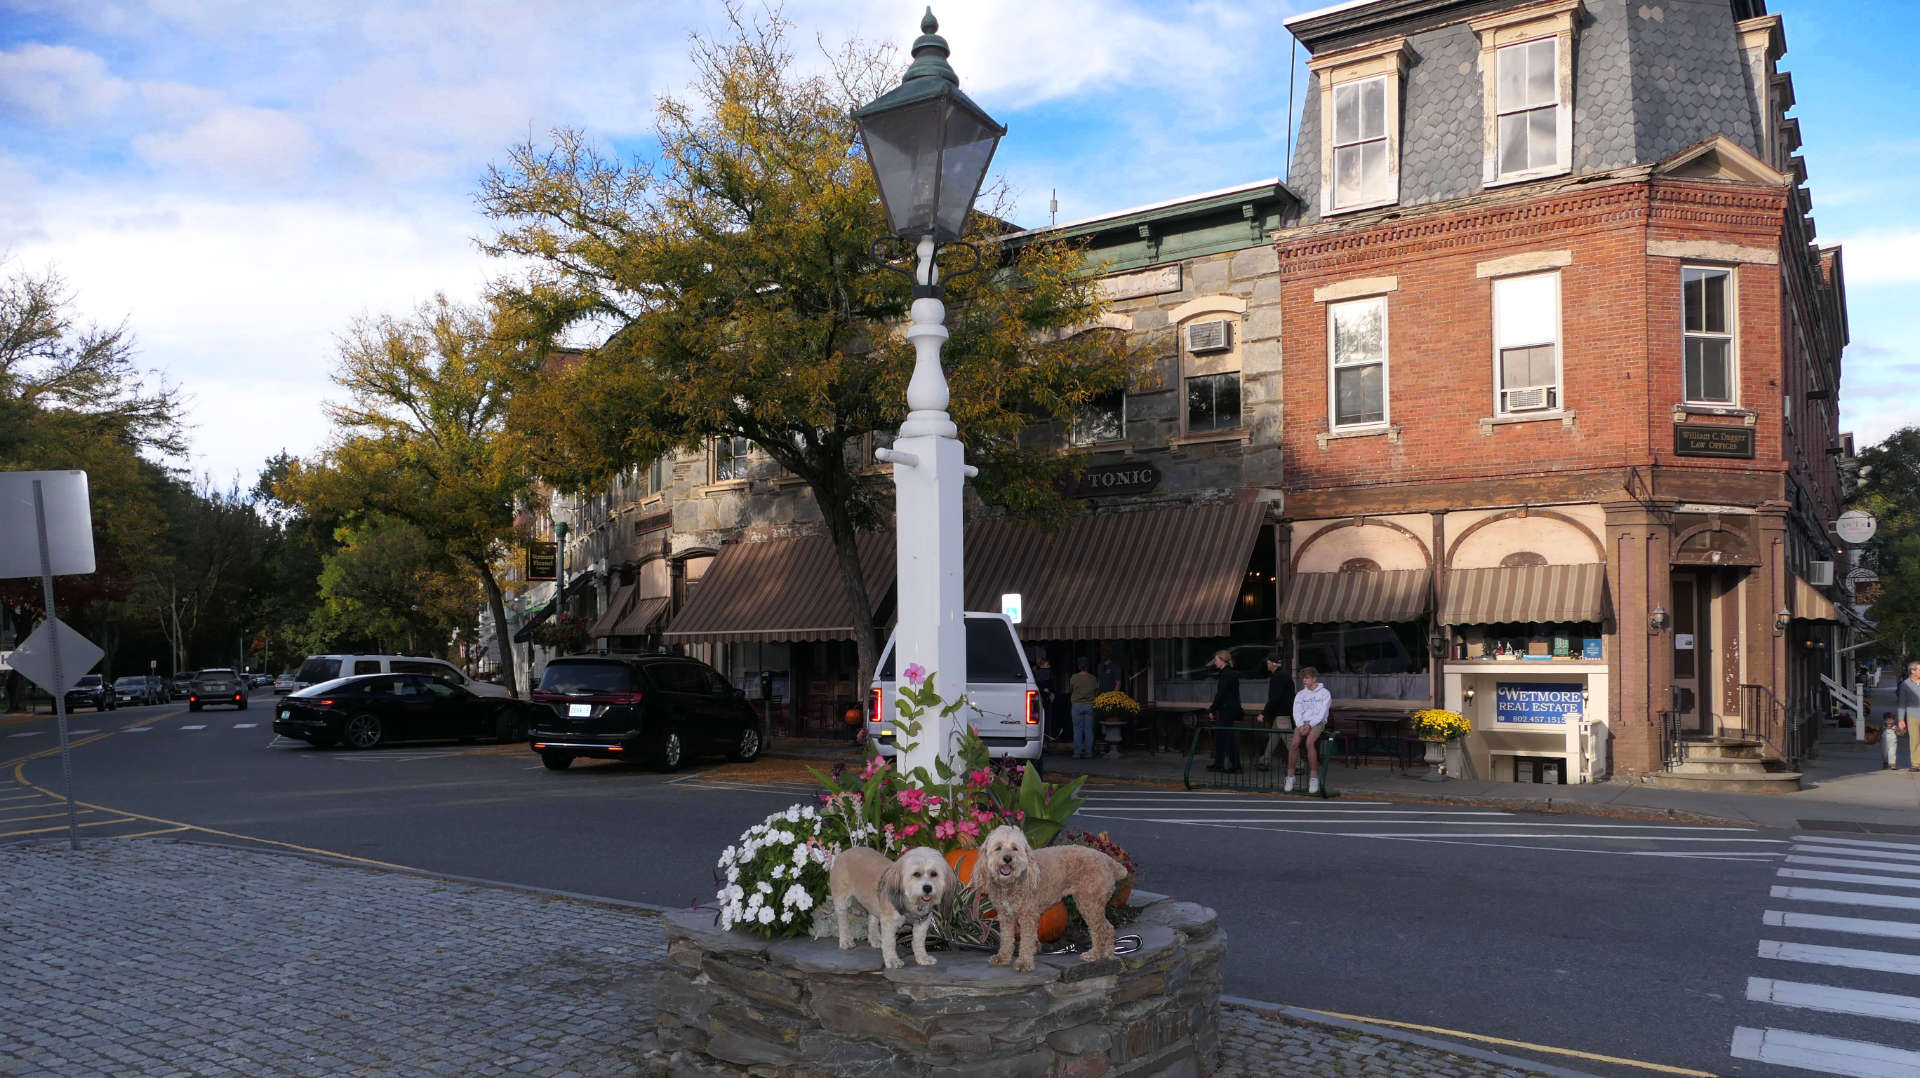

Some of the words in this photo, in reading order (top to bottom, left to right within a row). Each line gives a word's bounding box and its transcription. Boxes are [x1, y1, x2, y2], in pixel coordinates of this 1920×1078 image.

[1088, 469, 1152, 487] TONIC
[1498, 687, 1582, 703] WETMORE
[1499, 703, 1530, 712] REAL
[1532, 703, 1578, 713] ESTATE
